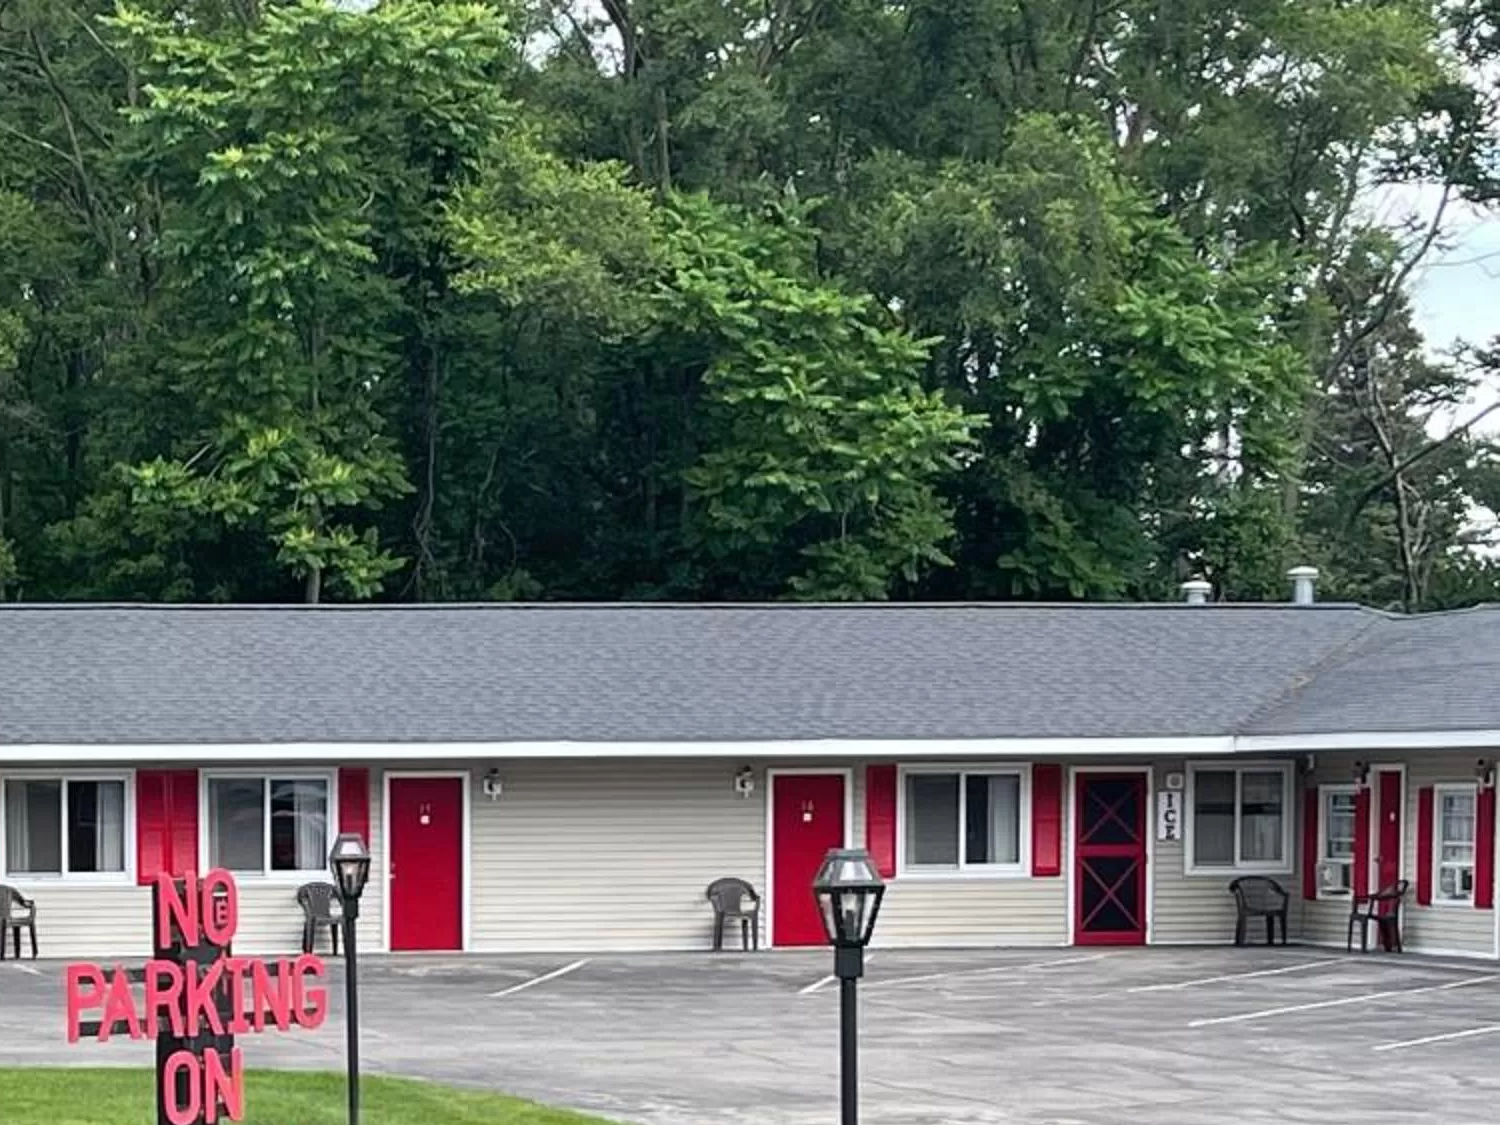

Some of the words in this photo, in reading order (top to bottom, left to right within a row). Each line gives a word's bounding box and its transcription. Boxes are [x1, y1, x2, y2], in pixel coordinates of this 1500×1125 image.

[1164, 793, 1177, 840] ICE
[157, 868, 238, 948] NO
[66, 953, 328, 1043] PARKING
